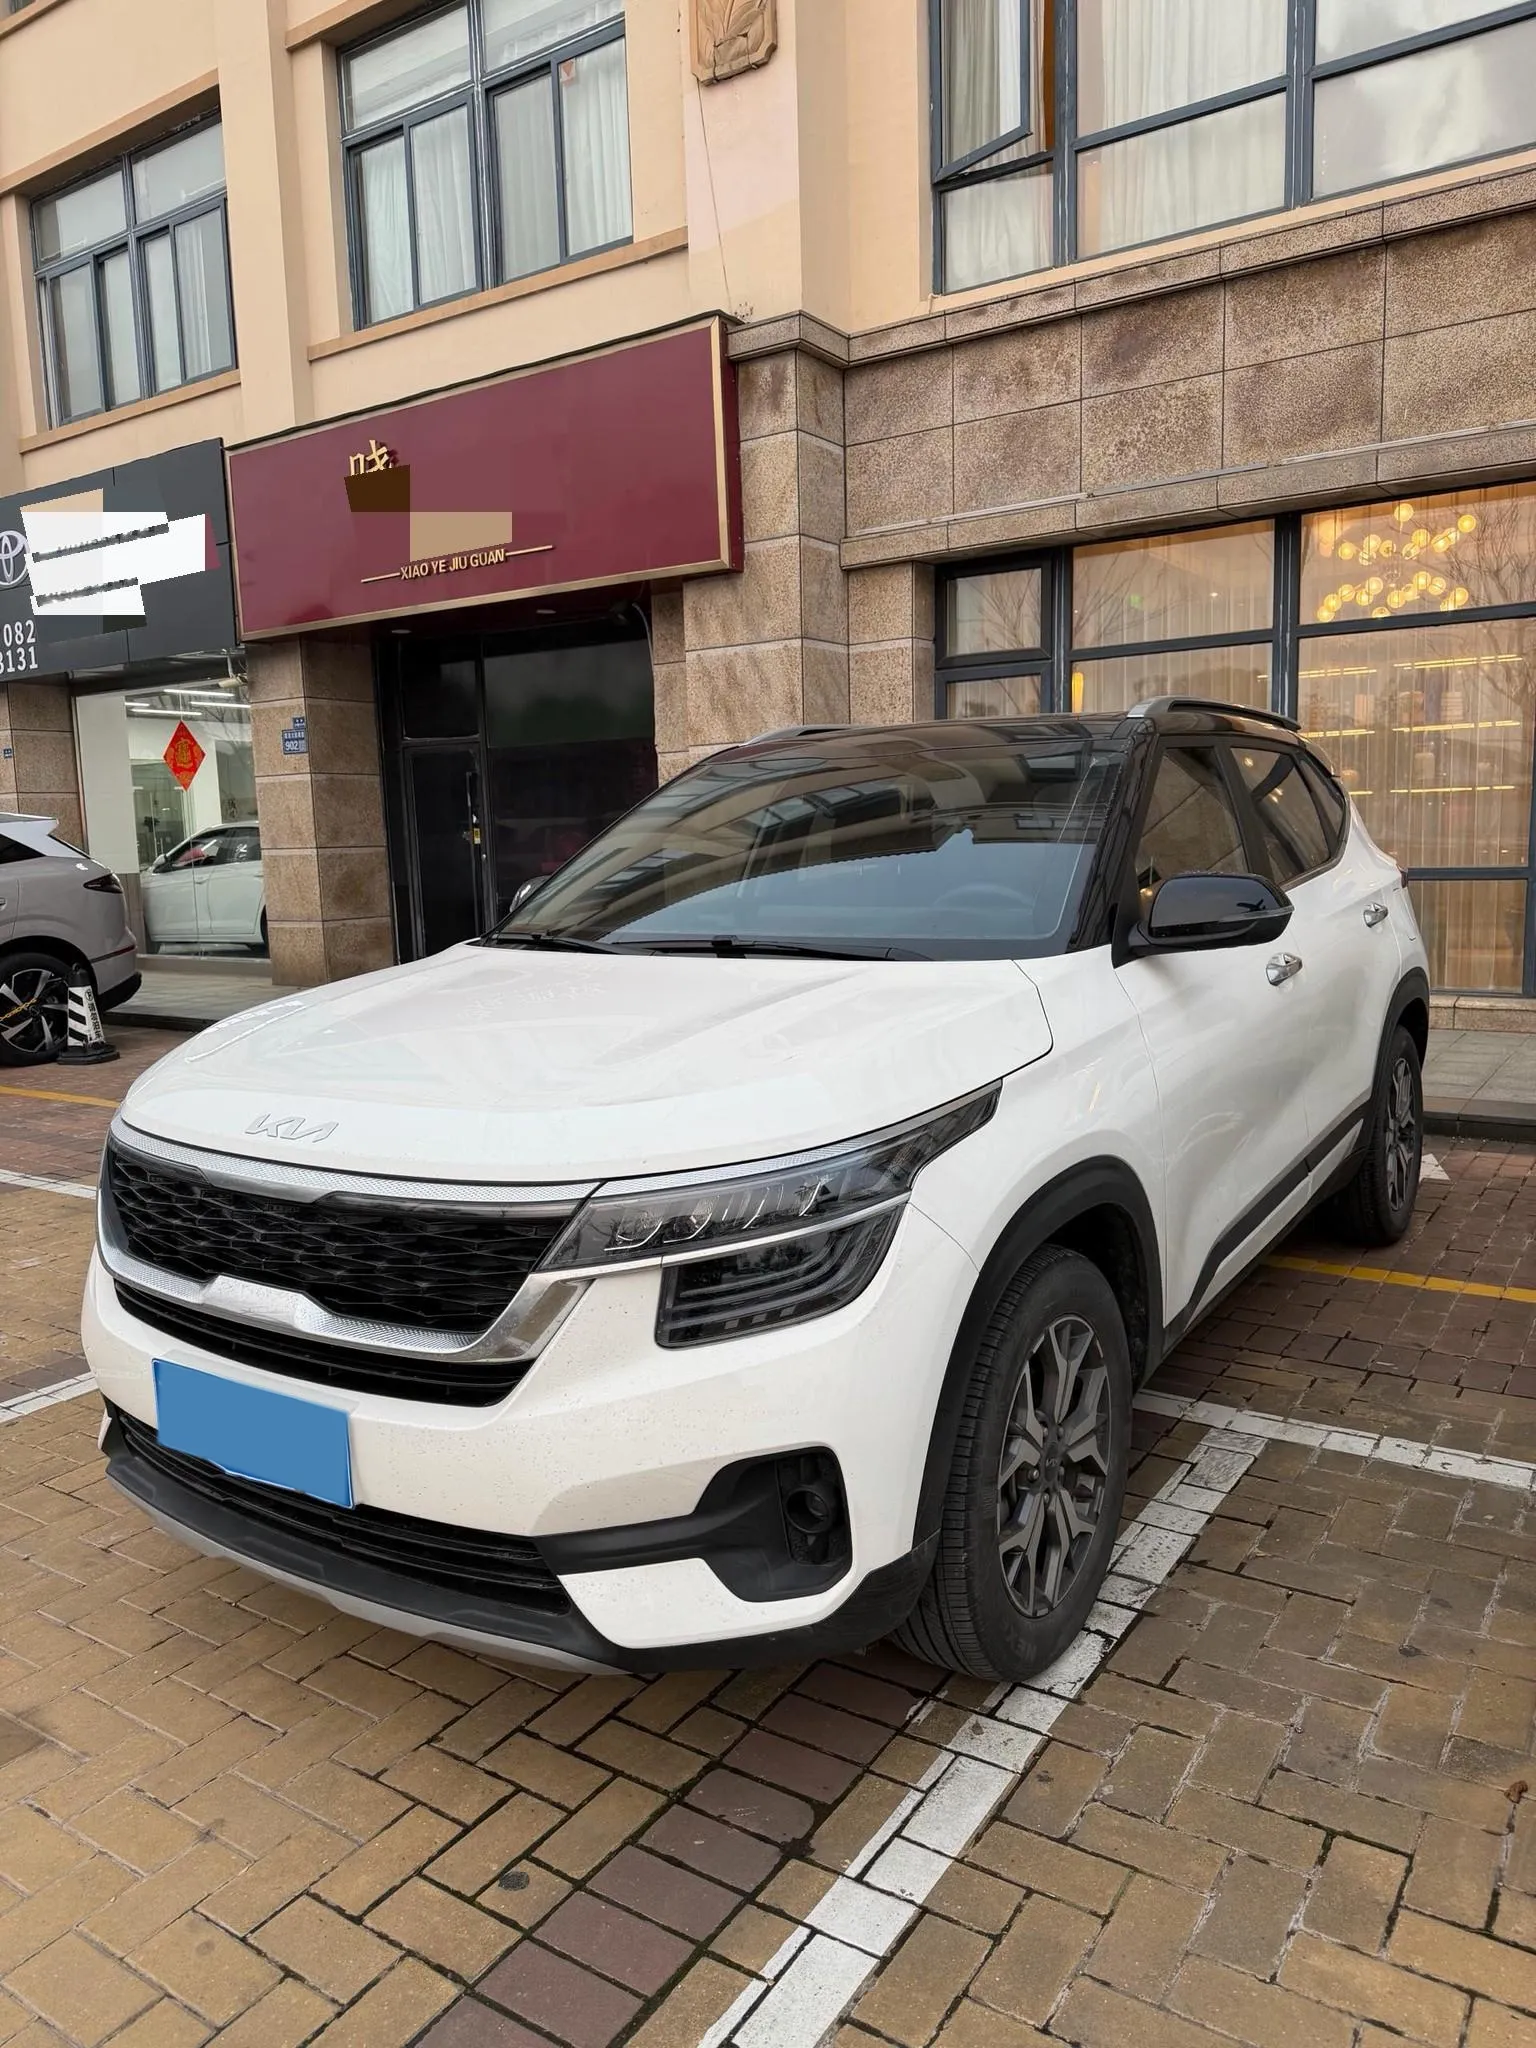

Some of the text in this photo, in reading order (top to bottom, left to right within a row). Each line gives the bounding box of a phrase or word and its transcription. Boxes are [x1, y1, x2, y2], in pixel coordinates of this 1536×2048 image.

[401, 549, 505, 580] XIAO YE JIU GUAN
[3, 620, 36, 647] 082
[245, 1113, 339, 1143] KIA
